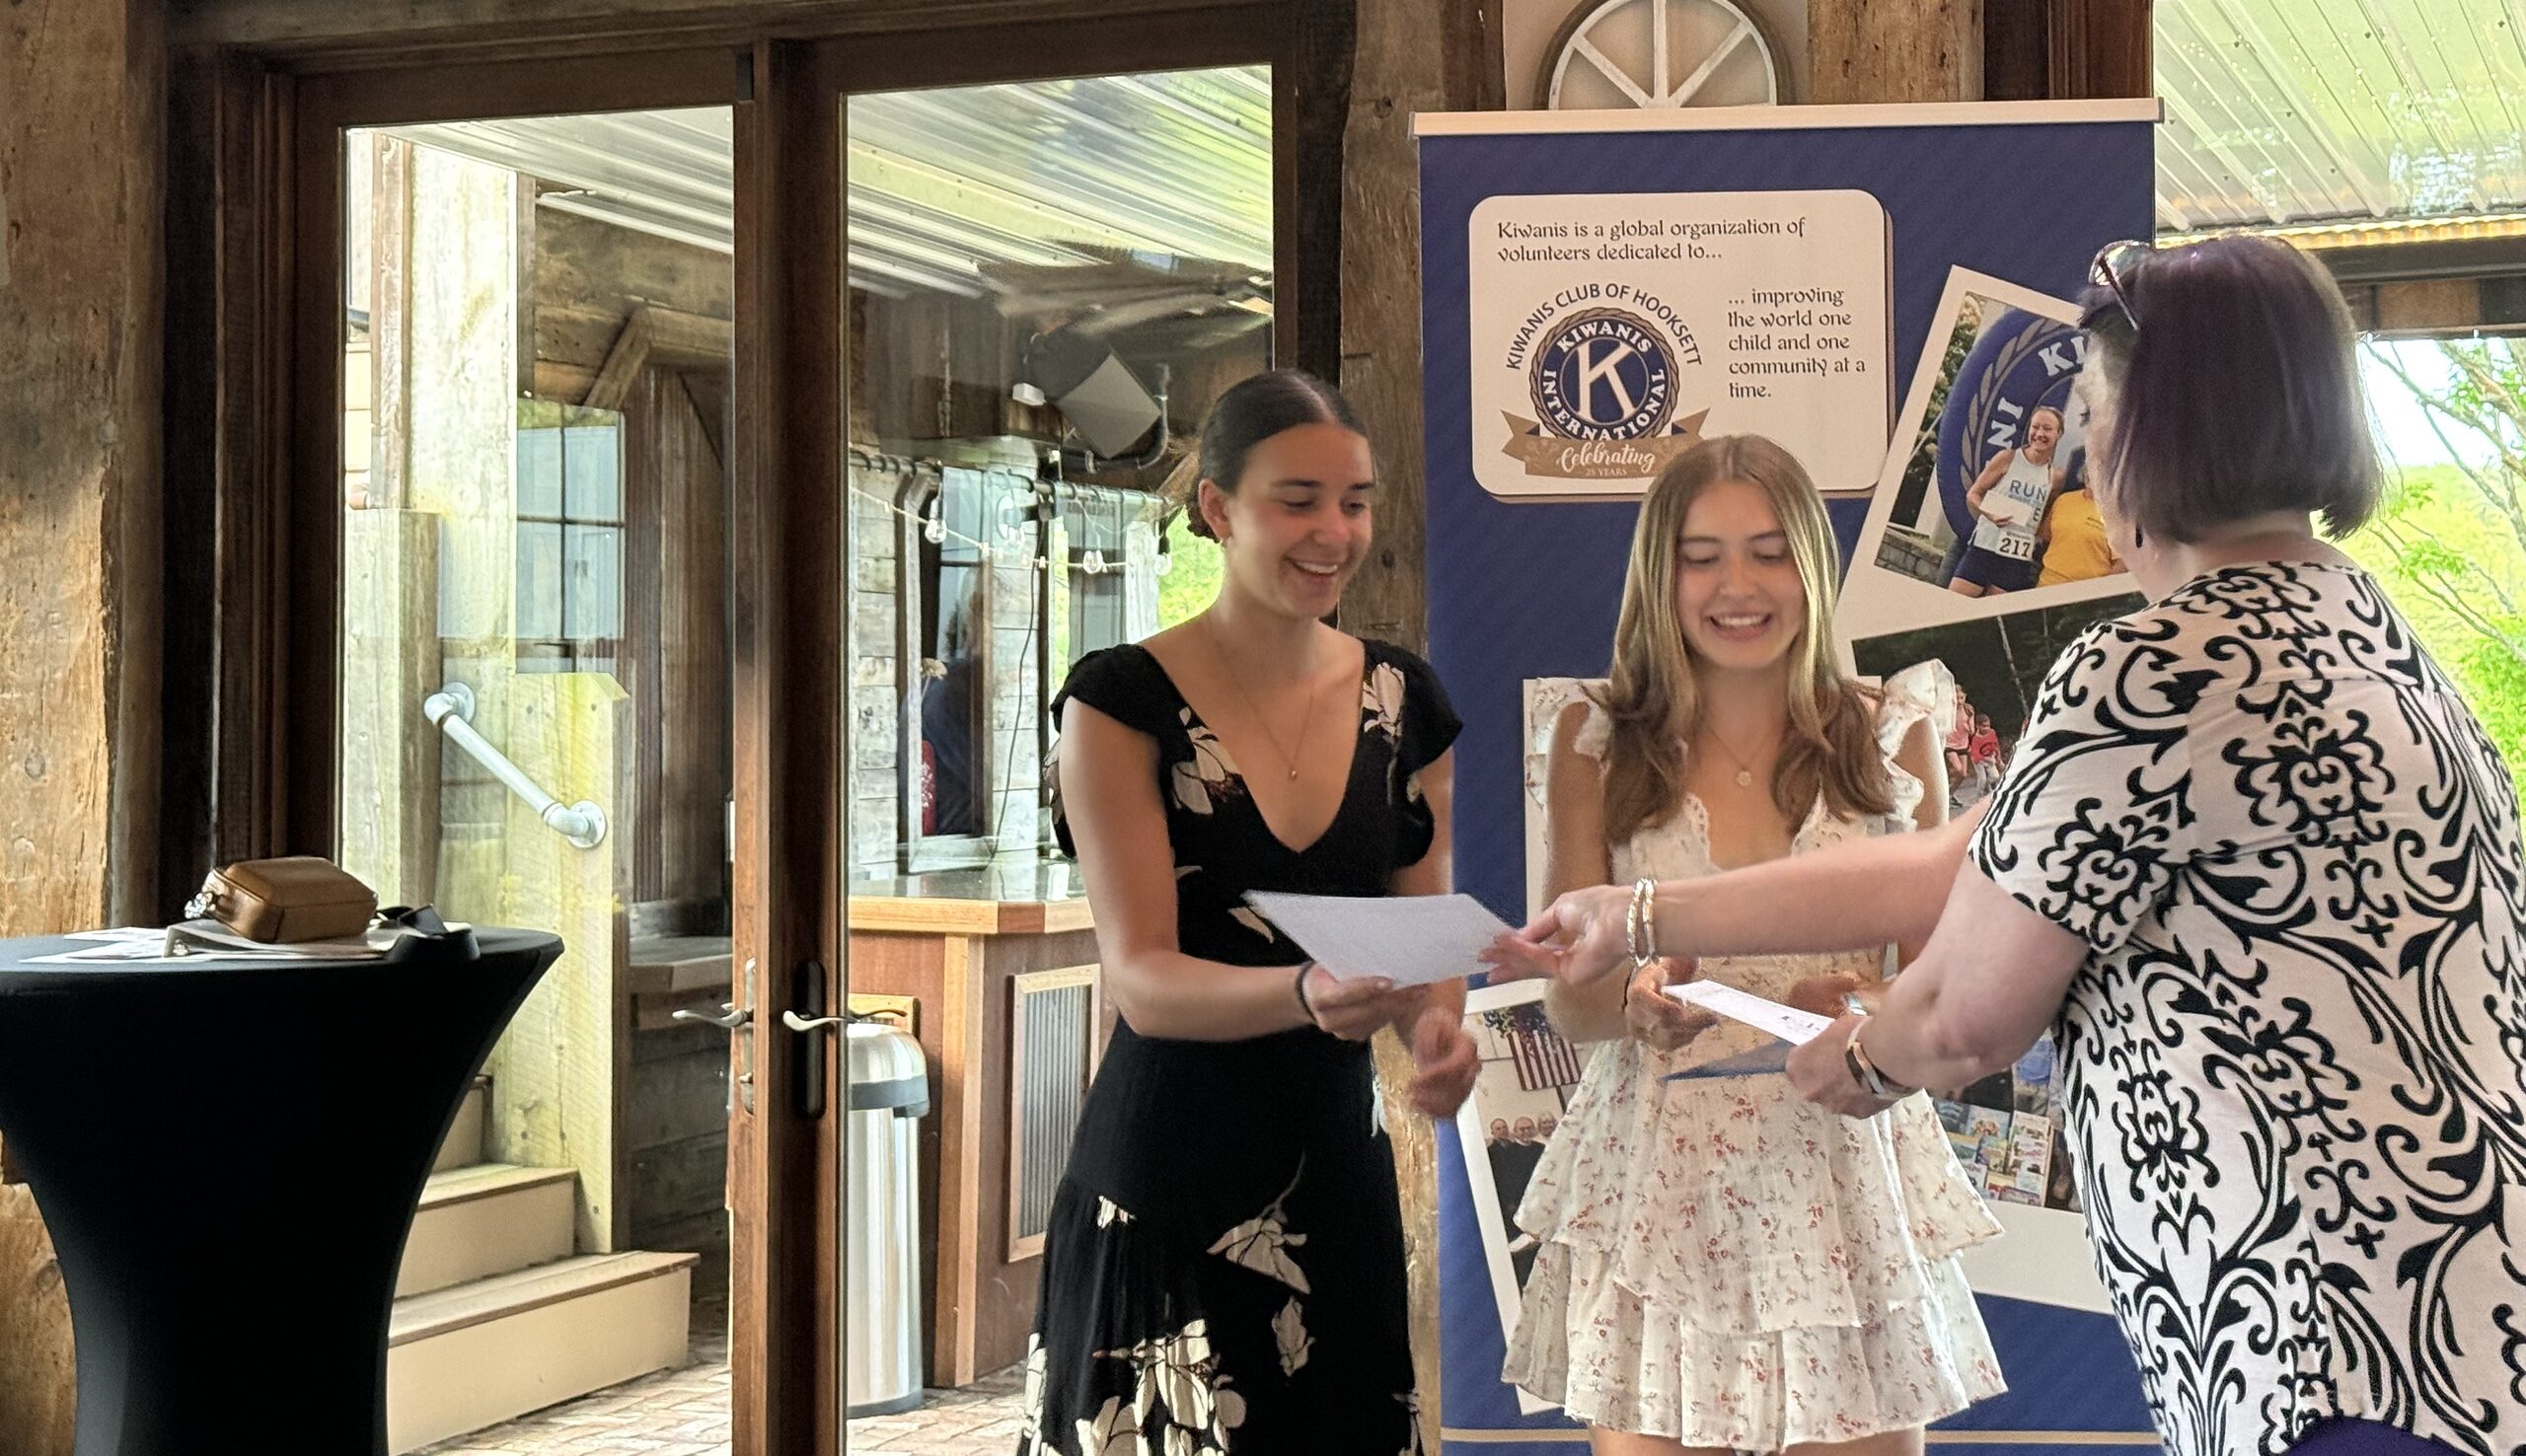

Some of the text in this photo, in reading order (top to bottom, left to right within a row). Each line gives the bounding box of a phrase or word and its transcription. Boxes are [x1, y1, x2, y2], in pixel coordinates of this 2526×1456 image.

[1498, 217, 1806, 241] Kiwanis is a global organization of
[1498, 243, 1722, 261] volunteers dedicated to...
[1751, 287, 1844, 308] improving
[1506, 283, 1702, 370] KIWANIS CLUB OF HOOKSETT
[1728, 309, 1851, 327] the world one
[1556, 321, 1652, 353] KIWANIS
[1729, 333, 1850, 350] child and one
[1729, 357, 1866, 377] community at a
[1729, 382, 1771, 398] time.
[1543, 369, 1665, 440] INTERNATIONAL
[1556, 441, 1655, 473] Celebrating
[1597, 468, 1627, 476] YEARS
[2010, 479, 2046, 501] RUN
[1999, 538, 2031, 557] 217
